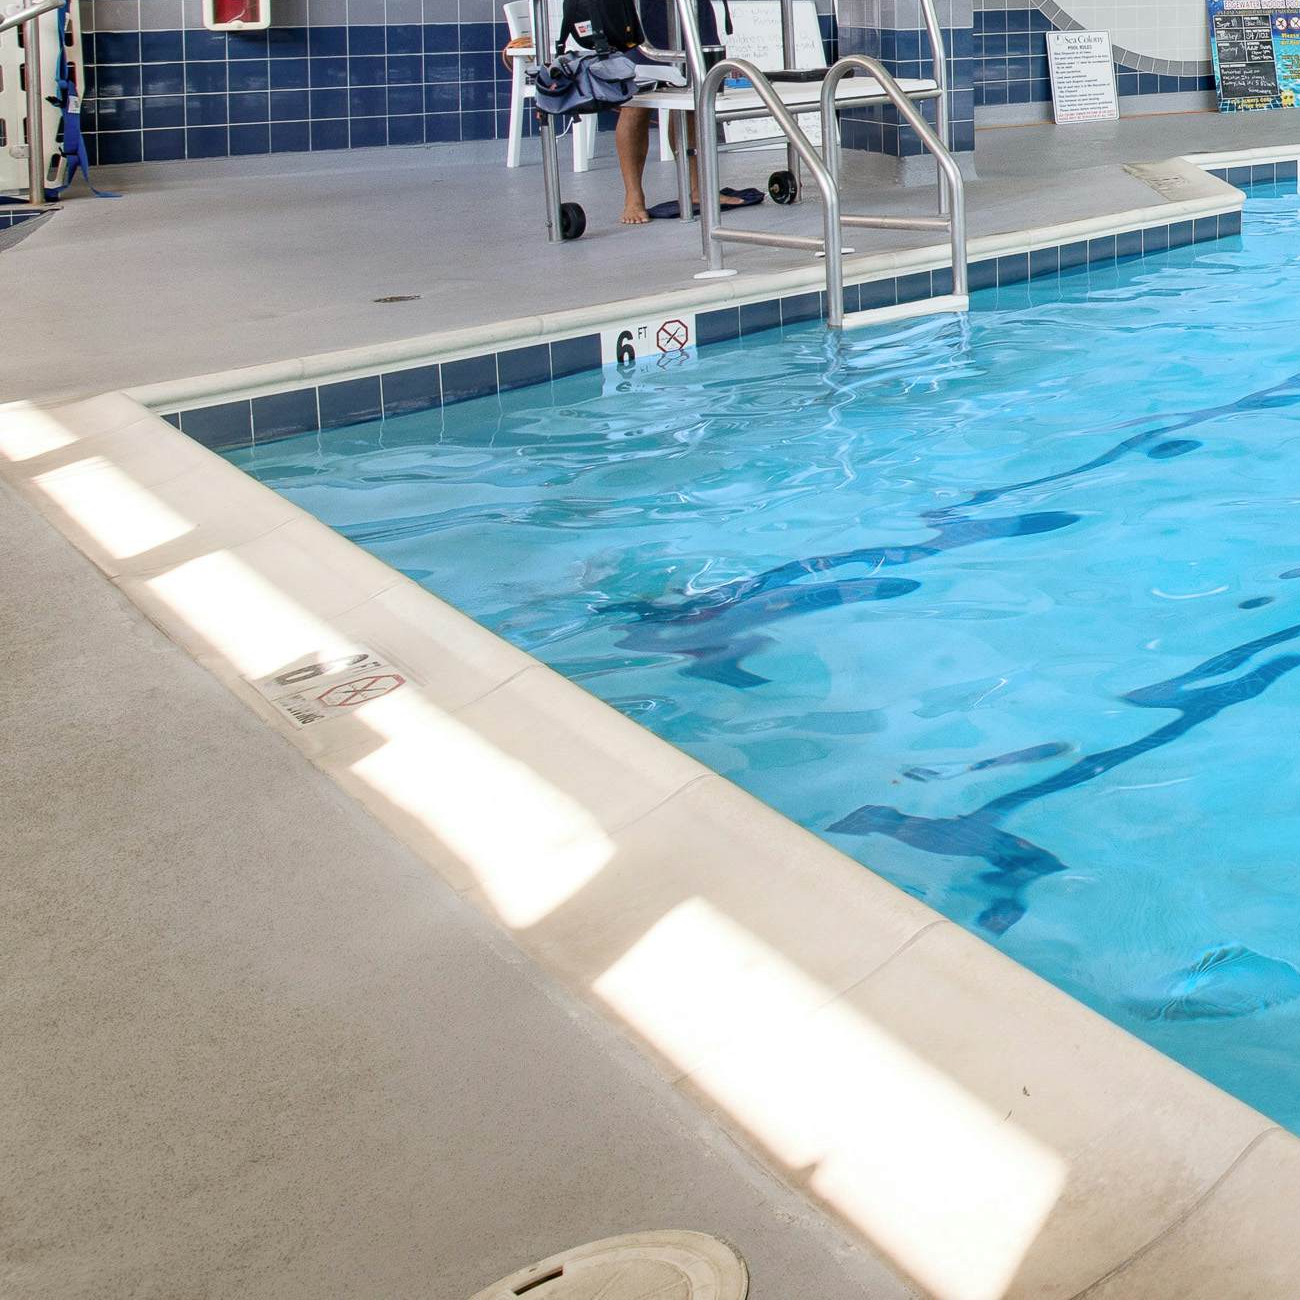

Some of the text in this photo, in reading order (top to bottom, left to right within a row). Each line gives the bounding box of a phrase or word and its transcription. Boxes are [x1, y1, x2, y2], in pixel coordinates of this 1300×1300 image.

[1262, 0, 1285, 8] INDOOR
[1065, 35, 1103, 44] Sea Colony
[616, 326, 647, 364] 6 FT
